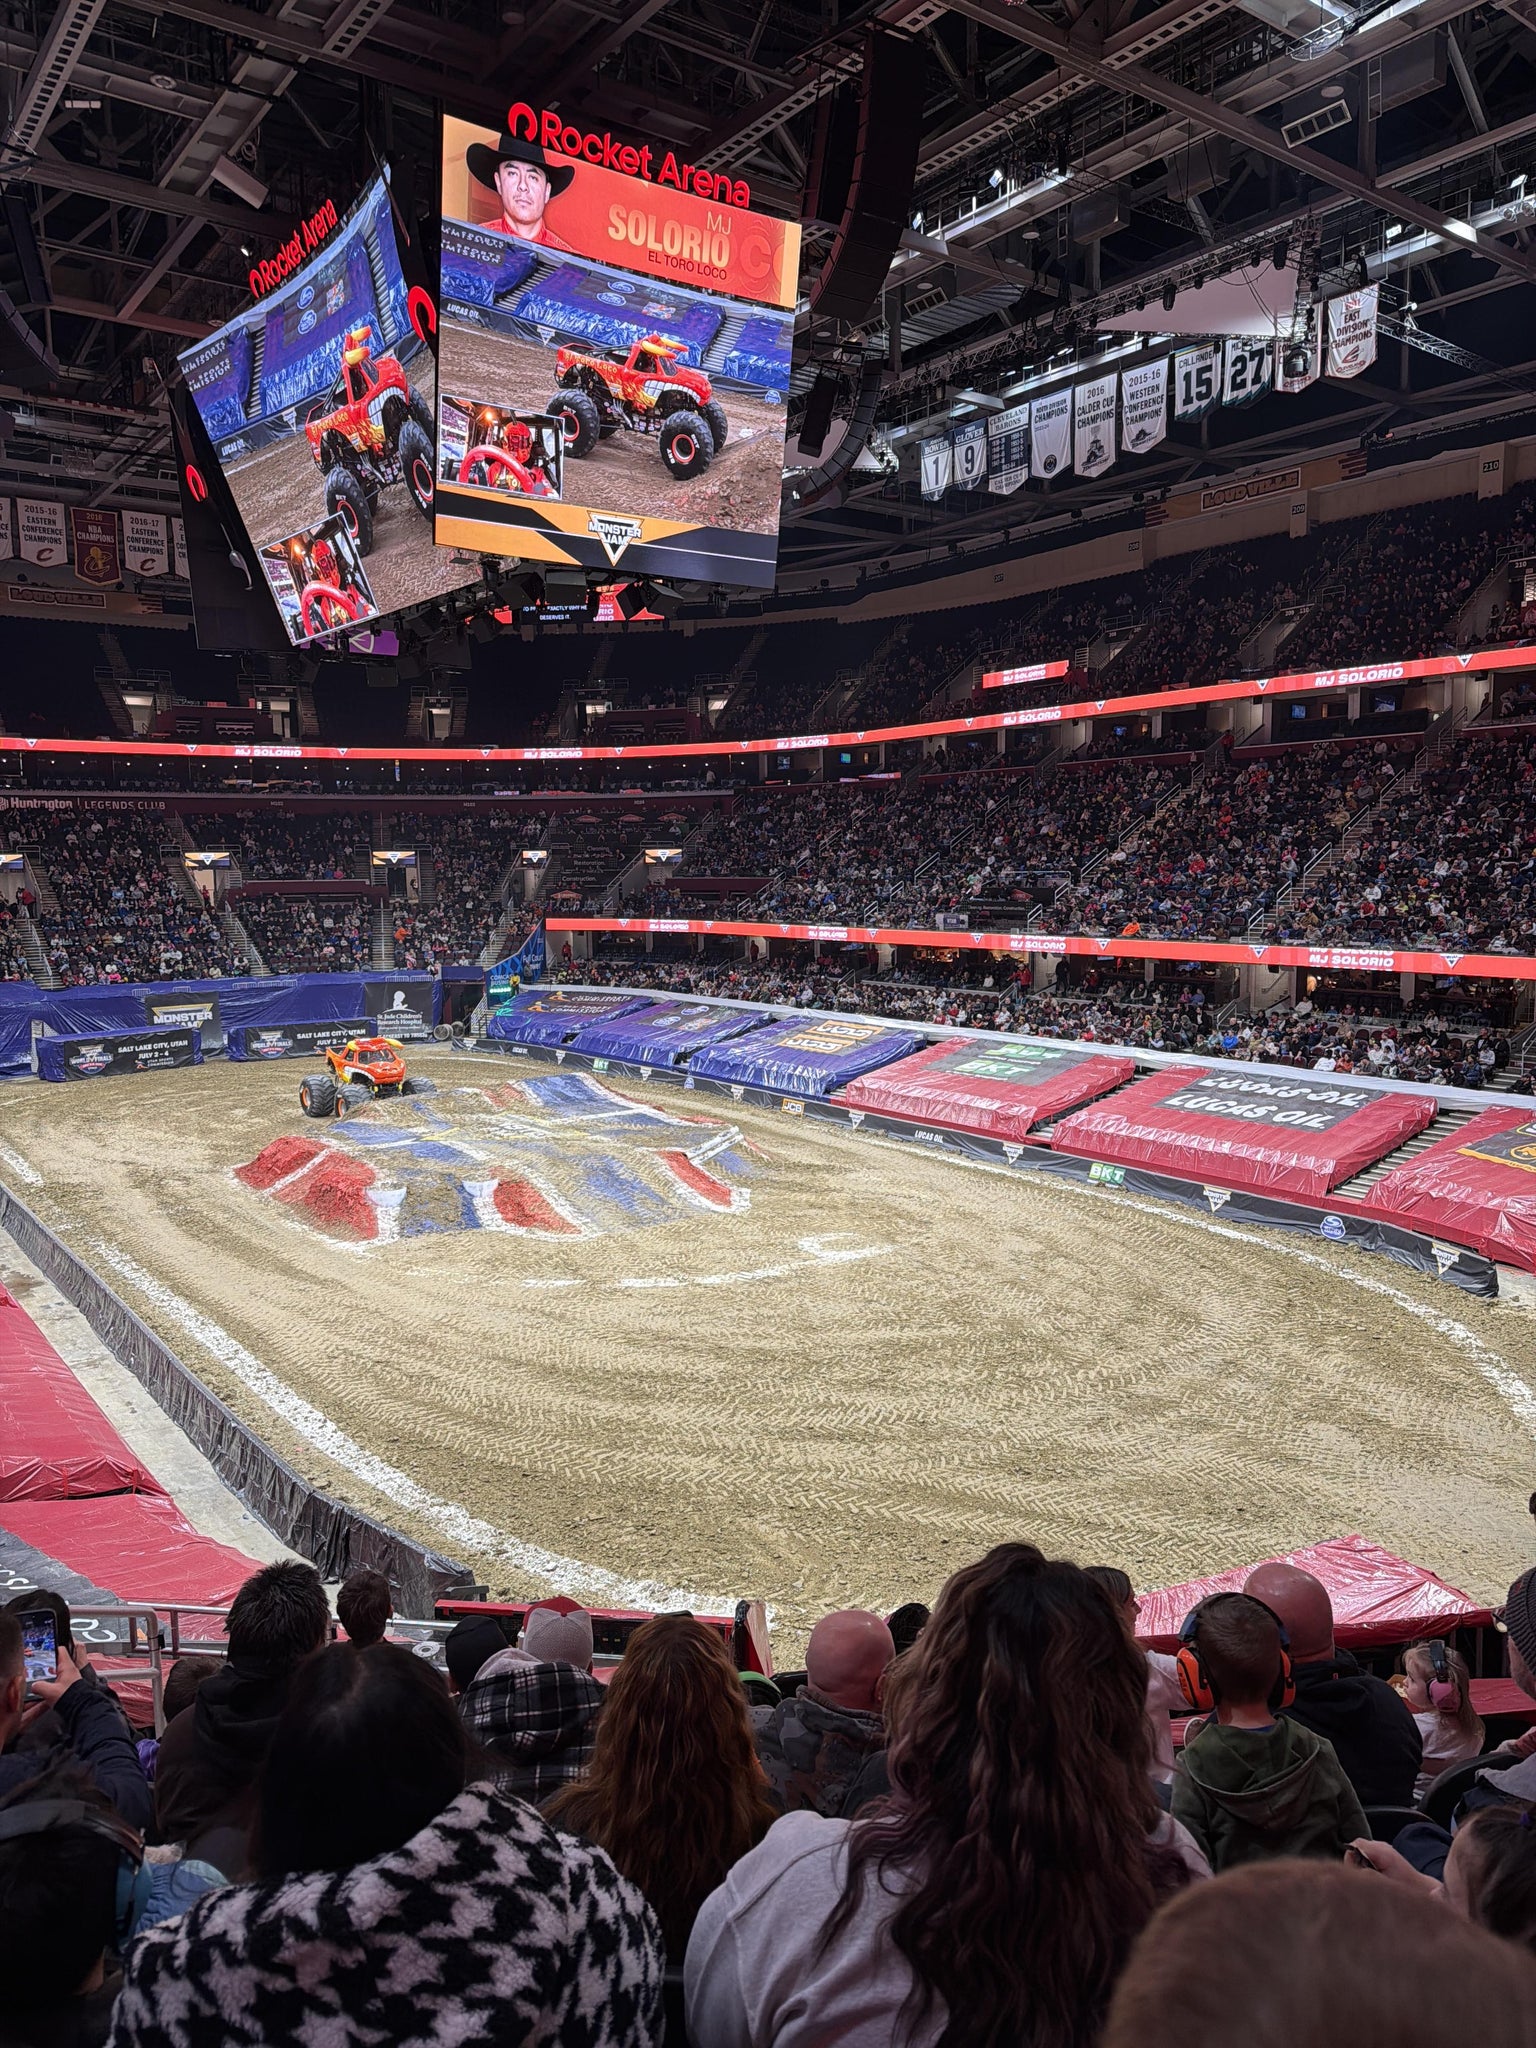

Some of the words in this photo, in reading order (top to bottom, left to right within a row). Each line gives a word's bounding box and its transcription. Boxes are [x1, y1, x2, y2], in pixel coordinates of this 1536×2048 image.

[541, 110, 652, 180] Rocket
[658, 152, 751, 208] Arena
[706, 211, 732, 236] MJ
[608, 203, 732, 268] SOLORIO
[259, 230, 305, 292] Rocket
[302, 199, 338, 258] Arena
[648, 250, 661, 264] EL
[662, 254, 694, 274] TORO
[697, 263, 727, 281] LOCO
[447, 303, 469, 318] LUCAS
[1344, 311, 1361, 323] EAST
[1336, 319, 1369, 337] DIVISION
[1331, 329, 1372, 350] CHAMPIONS
[1230, 347, 1265, 392] 27
[1128, 368, 1160, 388] 2015-16
[1183, 364, 1213, 406] 15
[1087, 385, 1105, 399] 2016
[1129, 383, 1160, 401] WESTERN
[1077, 400, 1101, 417] CALDER
[1102, 395, 1114, 408] CUP
[1124, 394, 1165, 414] CONFERENCE
[990, 407, 1027, 426] CLEVELAND
[1034, 405, 1068, 424] CHAMPIONS
[1077, 408, 1114, 429] CHAMPIONS
[1125, 407, 1162, 426] CHAMPIONS
[995, 417, 1021, 431] BARONS
[955, 428, 984, 443] GLOVER
[925, 440, 949, 454] BOWER
[965, 445, 975, 475] 9
[1482, 461, 1499, 472] 210
[932, 456, 940, 486] 1
[24, 504, 58, 516] 2015-16
[1292, 504, 1305, 514] 209
[27, 516, 56, 526] EASTERN
[129, 516, 159, 526] 2016-17
[21, 524, 63, 536] CONFERENCE
[88, 524, 102, 534] NBA
[131, 527, 159, 537] EASTERN
[589, 521, 642, 538] MONSTER
[24, 533, 62, 545] CHAMPIONS
[77, 532, 115, 544] CHAMPIONS
[126, 535, 165, 547] CONFERENCE
[603, 533, 627, 545] JAM
[128, 545, 164, 555] CHAMPIONS
[1014, 669, 1046, 680] SOLORIO
[1315, 675, 1335, 686] MJ
[1337, 667, 1404, 684] SOLORIO
[1019, 710, 1061, 724] SOLORIO
[791, 737, 829, 747] SOLORIO
[235, 749, 251, 757] MJ
[254, 749, 302, 757] SOLORIO
[540, 750, 582, 759] SOLORIO
[10, 798, 73, 811] Huntington
[85, 800, 134, 810] LEGENDS
[137, 801, 166, 811] CLUB
[819, 930, 848, 938] SOLORIO
[1010, 940, 1023, 948] MJ
[1025, 941, 1066, 950] SOLORIO
[1309, 954, 1328, 964] MJ
[1331, 955, 1394, 967] SOLORIO
[154, 1011, 213, 1025] MONSTER
[297, 1032, 312, 1040] SALT
[313, 1030, 330, 1038] LAKE
[331, 1029, 348, 1038] CITY,
[349, 1028, 366, 1036] UTAH
[135, 1044, 152, 1052] LAKE
[153, 1042, 170, 1050] CITY,
[784, 1102, 802, 1112] JCB
[1164, 1094, 1278, 1119] LUCAS
[914, 1130, 935, 1141] LUCAS
[935, 1134, 944, 1143] OIL
[1090, 1166, 1124, 1182] BKT
